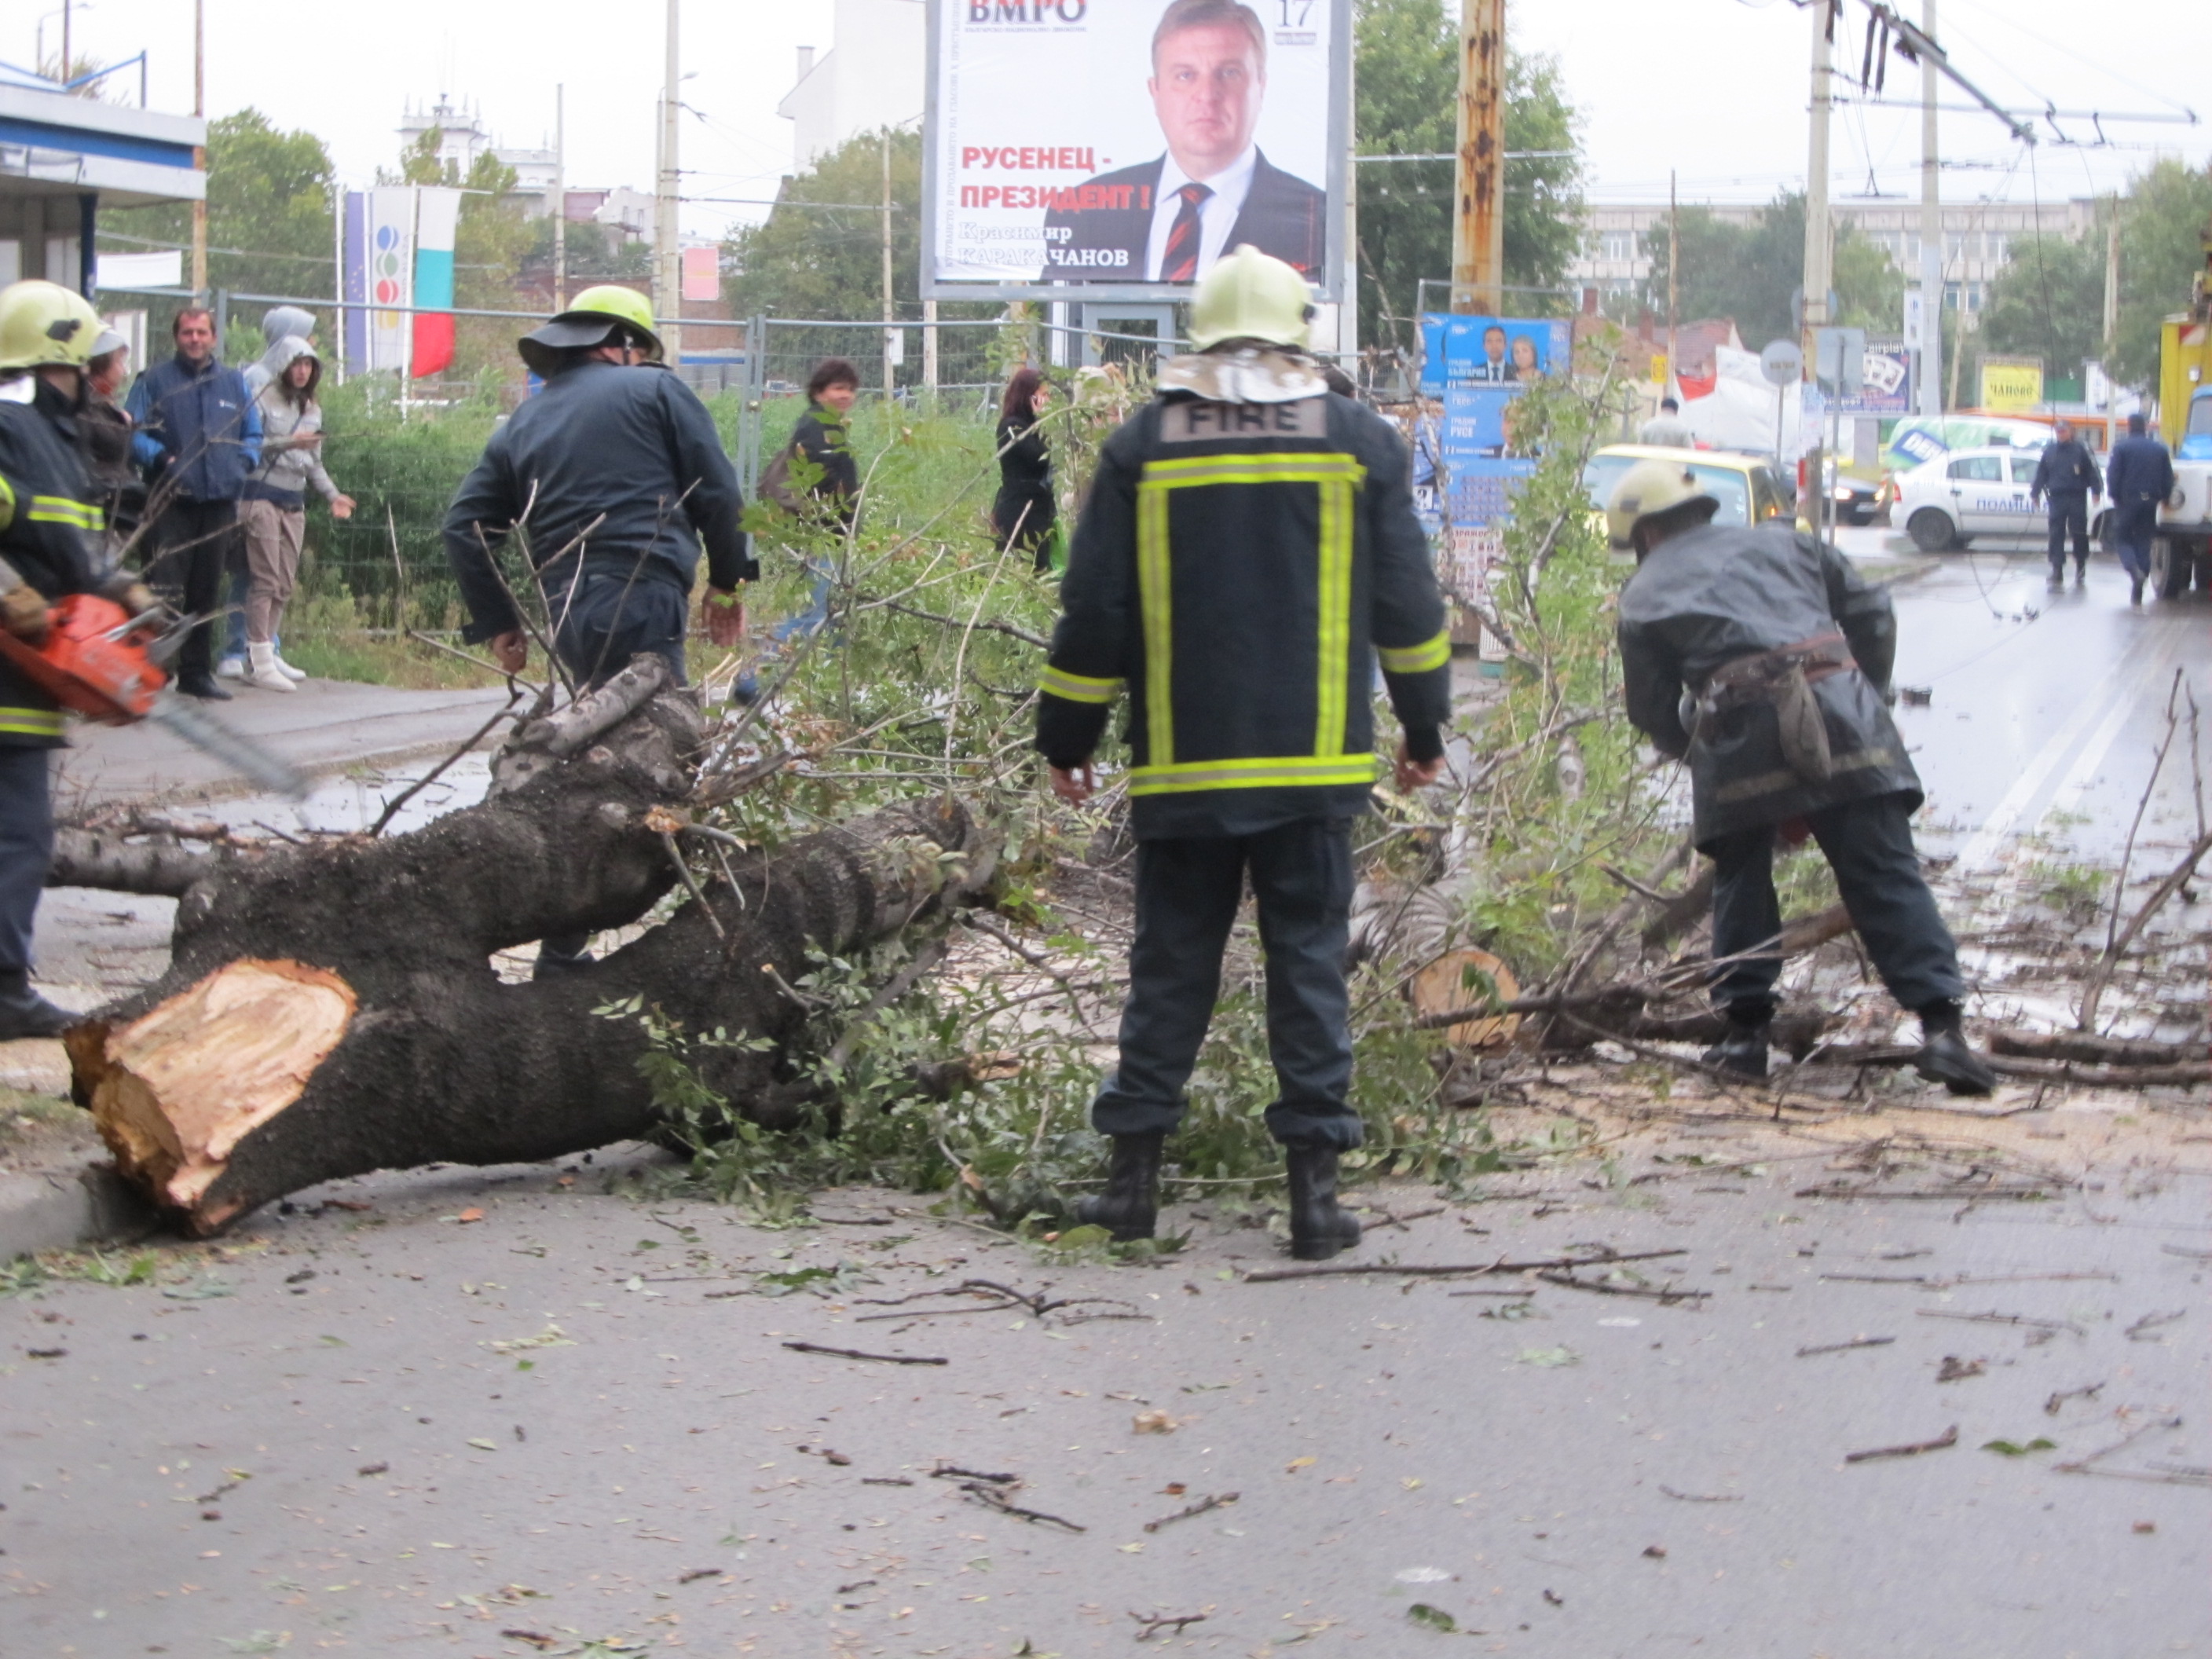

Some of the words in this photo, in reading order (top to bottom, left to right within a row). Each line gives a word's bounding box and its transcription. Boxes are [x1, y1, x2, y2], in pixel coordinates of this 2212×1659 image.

[967, 0, 1088, 24] ВМРО
[1278, 0, 1313, 27] 17
[961, 147, 1096, 173] РУСЕНЕЦ
[961, 185, 1134, 213] ПРЕЗИДЕНТ
[958, 222, 1073, 244] Красимир
[958, 248, 1130, 266] КАРАКАЧАНОВ
[1188, 403, 1300, 434] FIRE
[1450, 426, 1474, 438] РУСЕ
